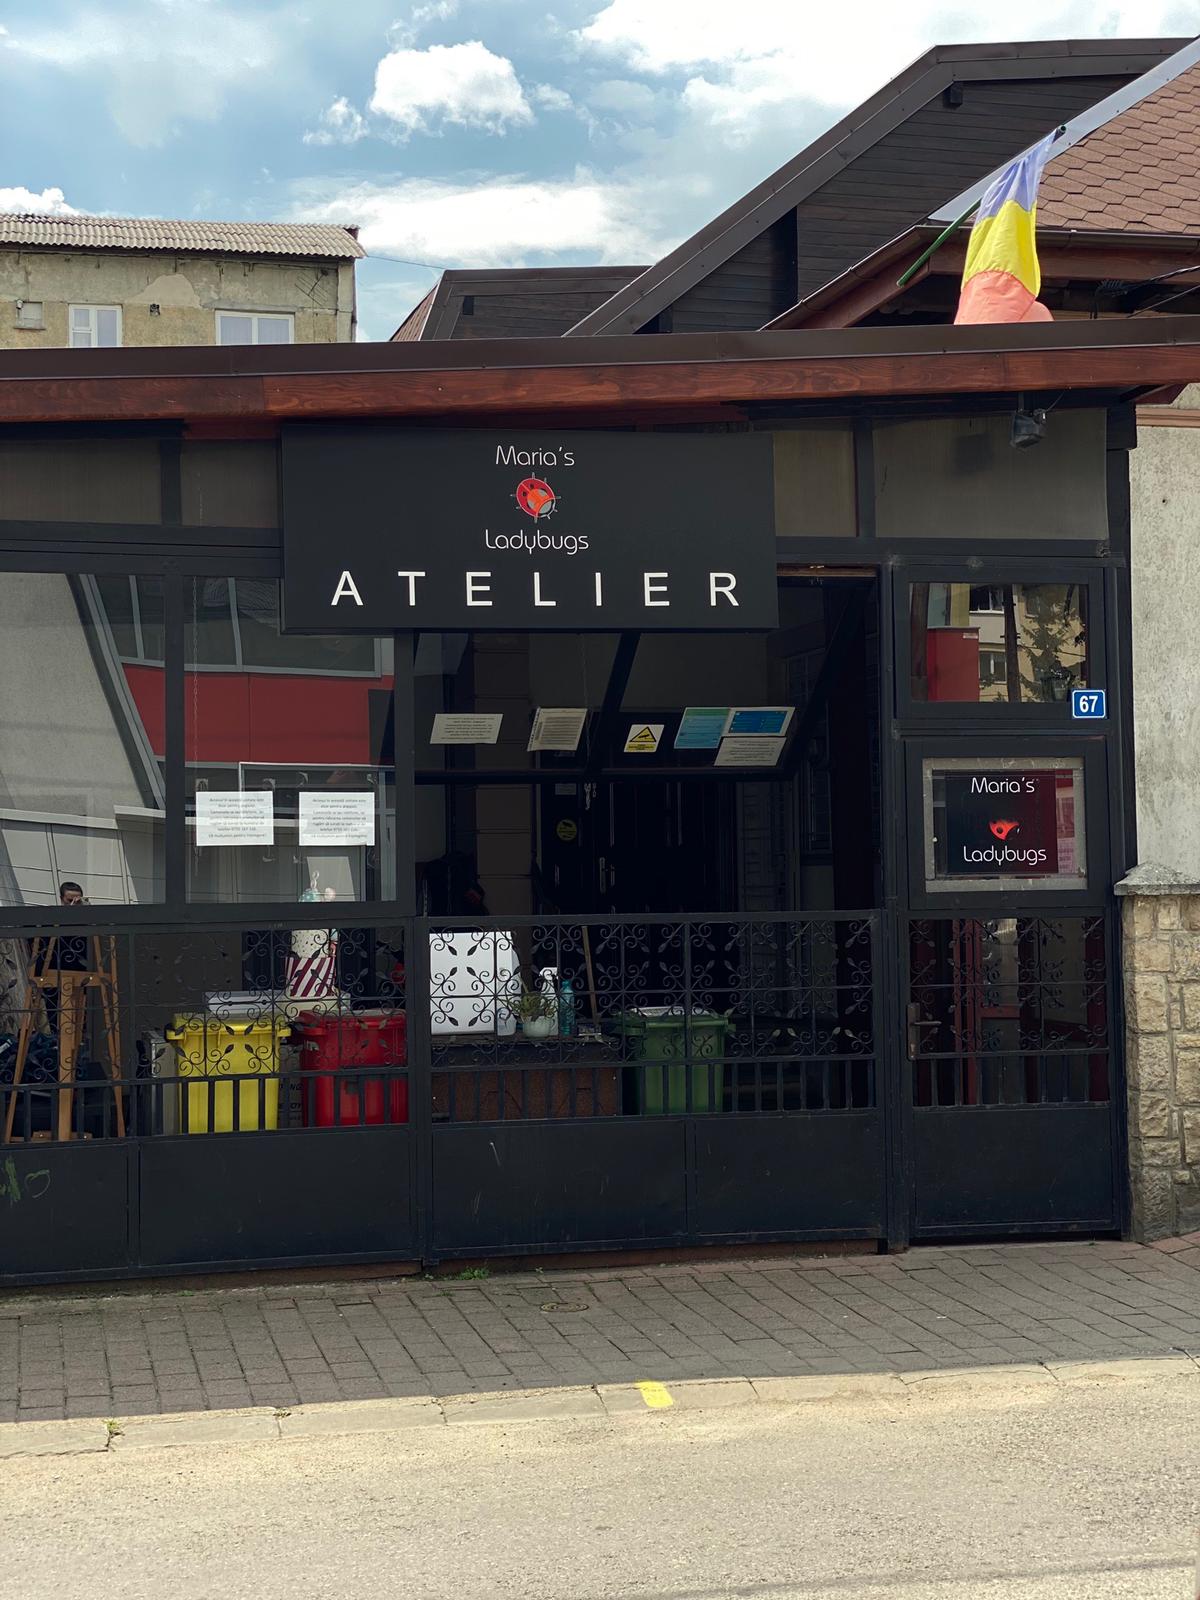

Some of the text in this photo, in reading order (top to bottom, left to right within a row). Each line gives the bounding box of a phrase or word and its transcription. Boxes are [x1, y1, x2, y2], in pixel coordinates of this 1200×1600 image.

[495, 444, 576, 467] Maria's
[485, 528, 590, 556] Ladybugs
[330, 570, 740, 608] ATELIER
[1079, 695, 1098, 713] 67
[971, 776, 1035, 794] Maria's
[963, 845, 1047, 866] Ladybugs
